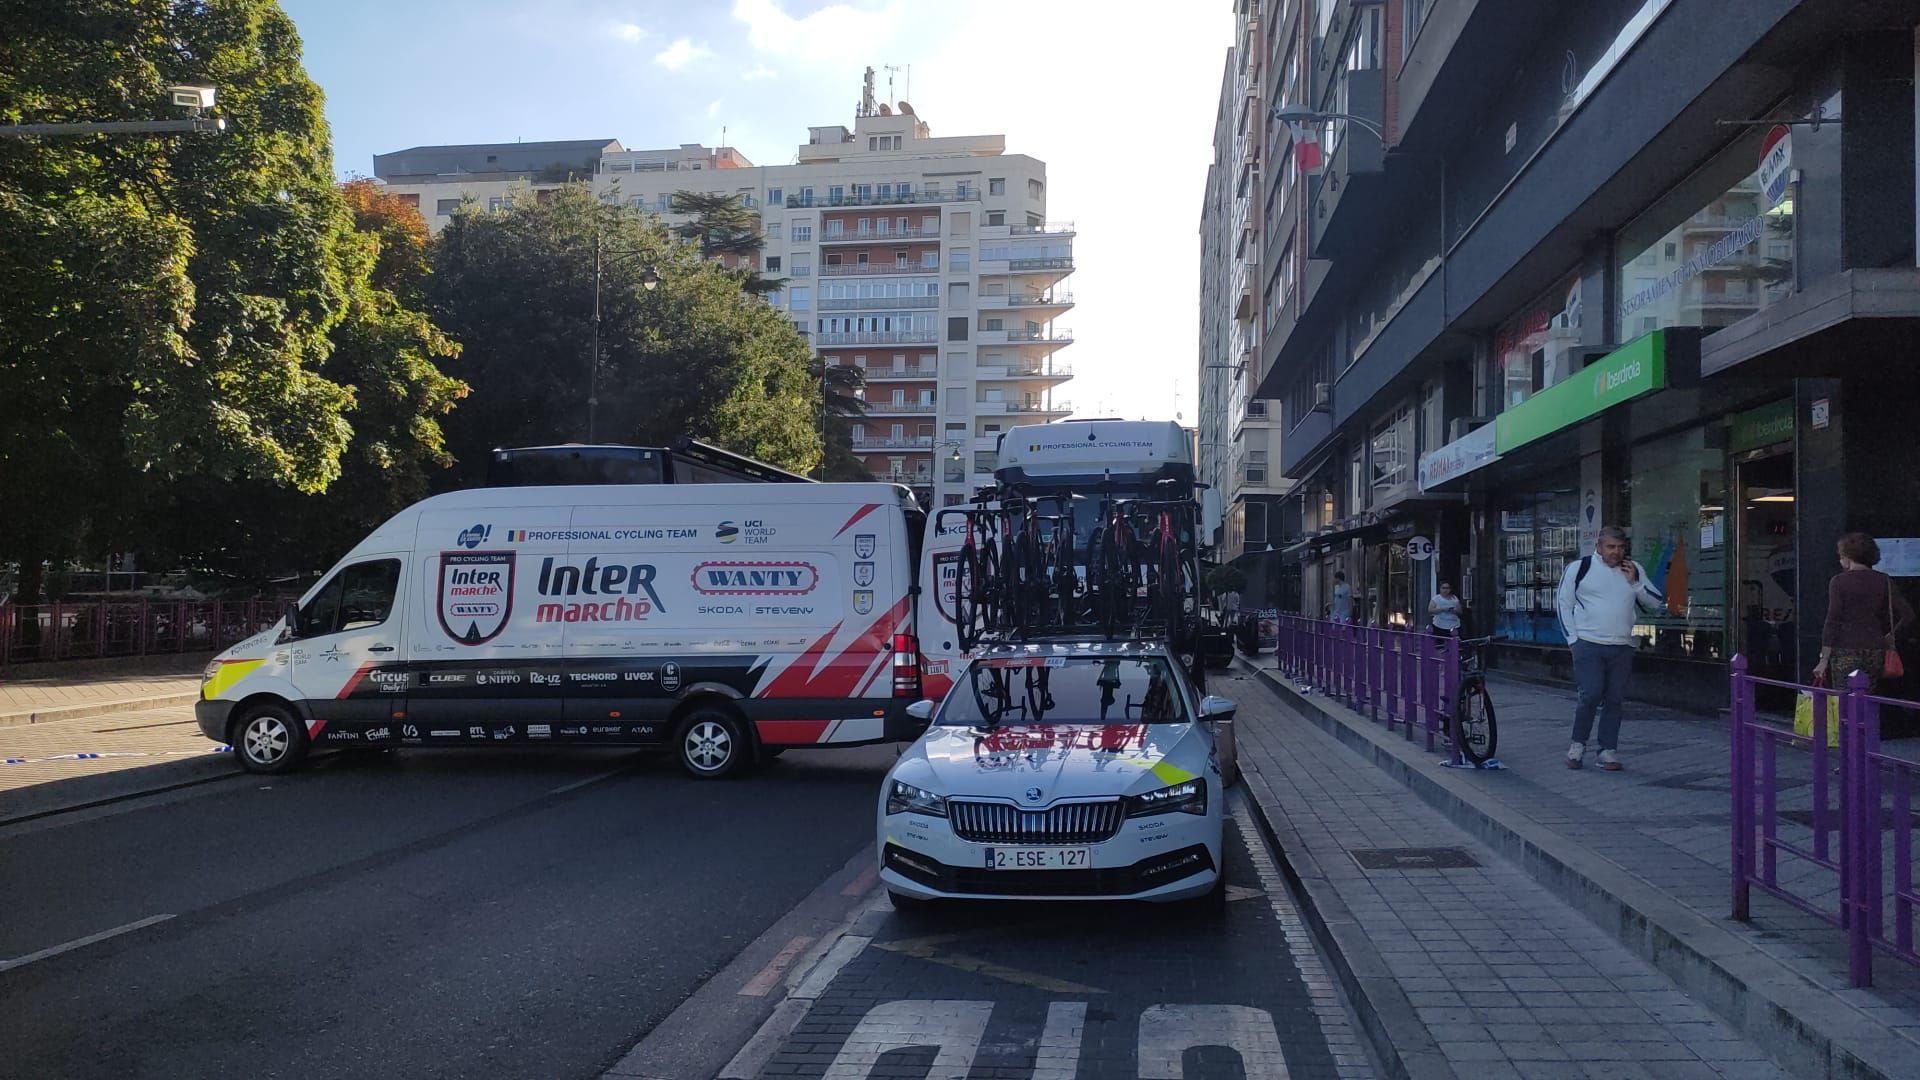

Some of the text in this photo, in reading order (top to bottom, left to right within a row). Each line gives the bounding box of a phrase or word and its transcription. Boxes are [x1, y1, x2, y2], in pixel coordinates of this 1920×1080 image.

[1606, 359, 1641, 391] Iberdrola
[1042, 440, 1153, 451] PROFESSIONAL CYCLING TEAM
[744, 519, 763, 528] UCI
[527, 528, 698, 541] PROFESSIONAL CYCLING TEAM
[744, 527, 777, 537] WORLD
[743, 536, 768, 545] TEAM
[707, 570, 803, 587] WANTY
[697, 606, 815, 615] SKODA STEVENY
[369, 670, 410, 682] Circus
[429, 674, 467, 682] CUBE
[489, 674, 521, 684] NIPPO
[569, 672, 618, 681] TECHNORD
[327, 732, 359, 740] FANTINI
